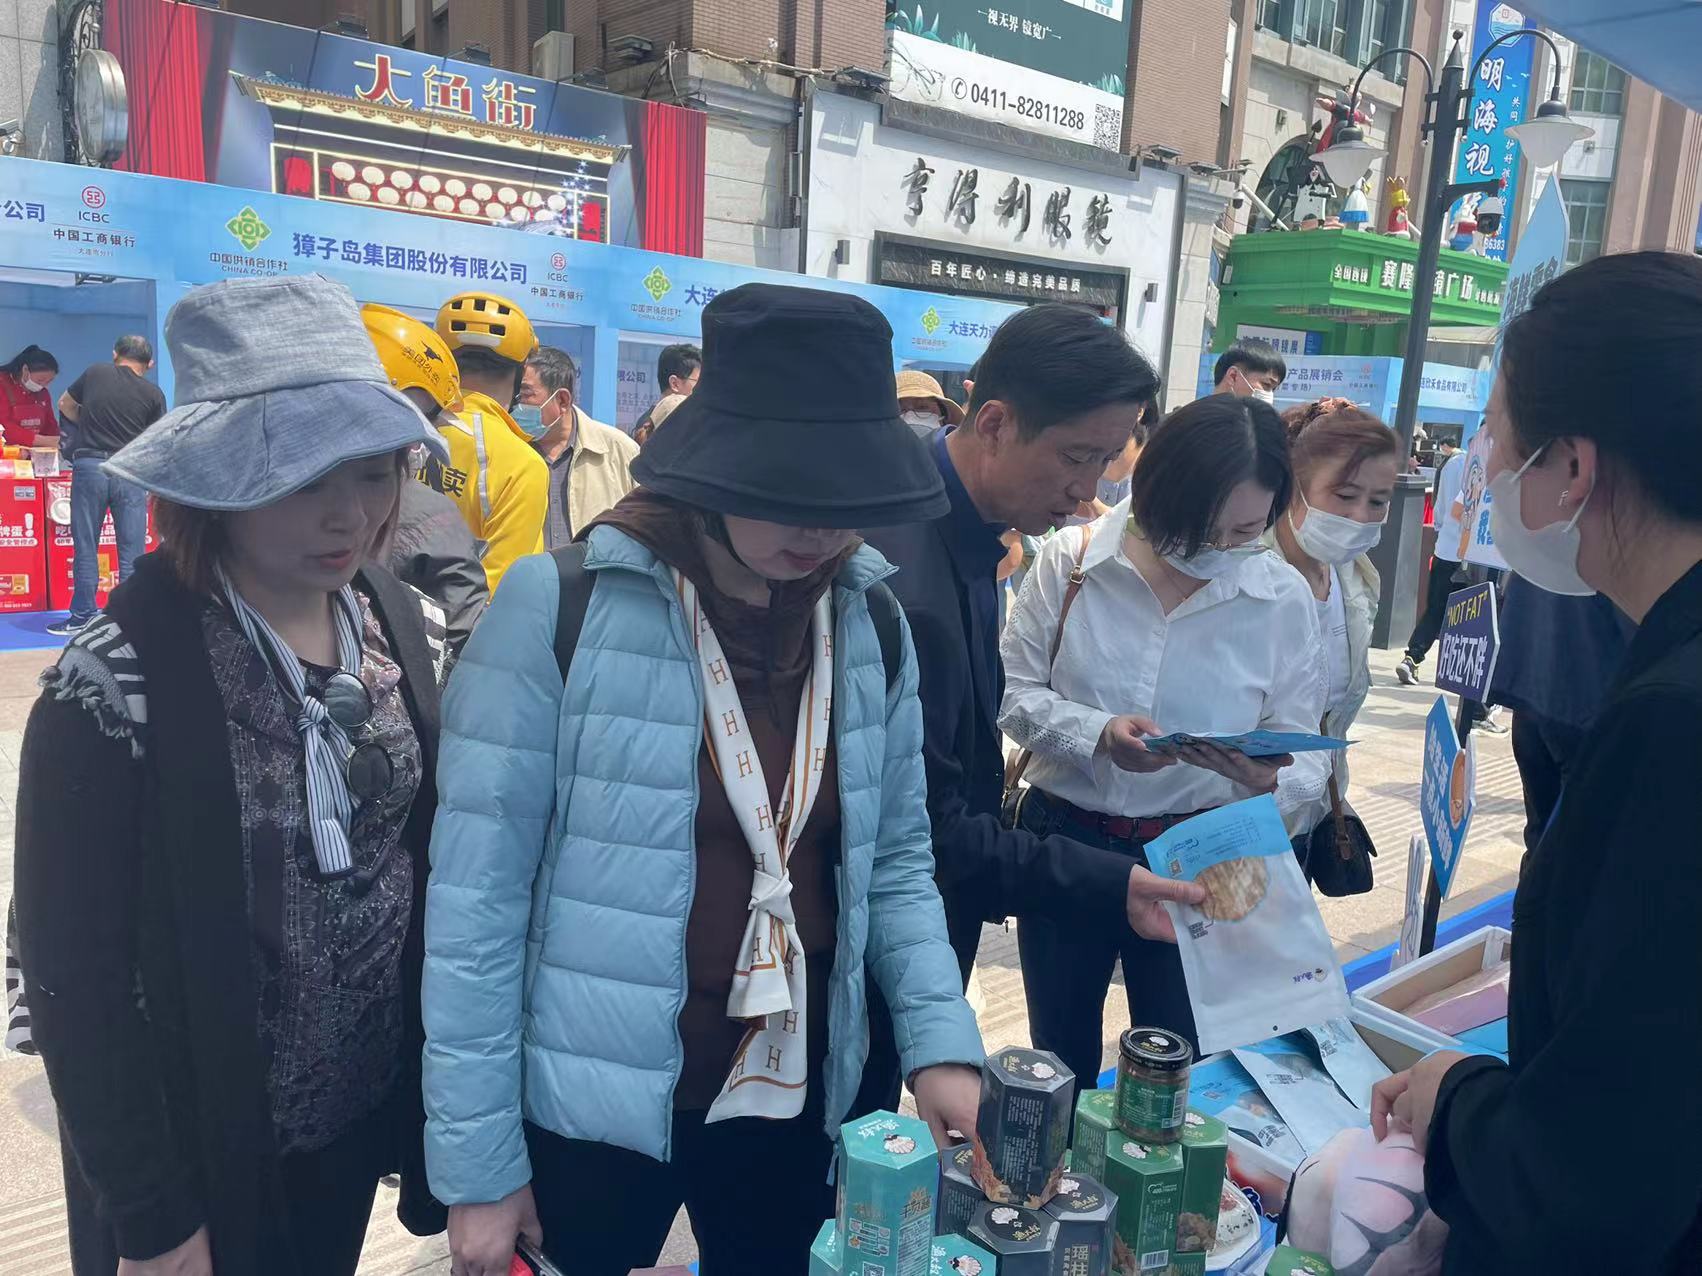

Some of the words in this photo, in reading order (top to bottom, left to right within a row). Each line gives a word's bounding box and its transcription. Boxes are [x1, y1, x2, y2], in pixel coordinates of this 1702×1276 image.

[353, 53, 537, 130] 大鱼街
[970, 83, 1085, 130] 0411-82811288
[78, 210, 110, 224] ICBC
[53, 228, 136, 248] 中国工商银行
[209, 252, 288, 271] 中国供销合作社
[221, 264, 249, 274] CHINA
[292, 230, 529, 286] 獐子岛集团股份有限公司
[546, 272, 569, 283] ICBC
[530, 286, 584, 302] 中国工商银行
[1287, 368, 1344, 382] 产品展销会
[708, 658, 729, 685] H
[722, 709, 740, 737] H
[736, 750, 753, 778] H
[813, 747, 827, 772] H
[756, 804, 772, 832] H
[783, 1009, 799, 1034] H
[766, 1044, 782, 1072] H
